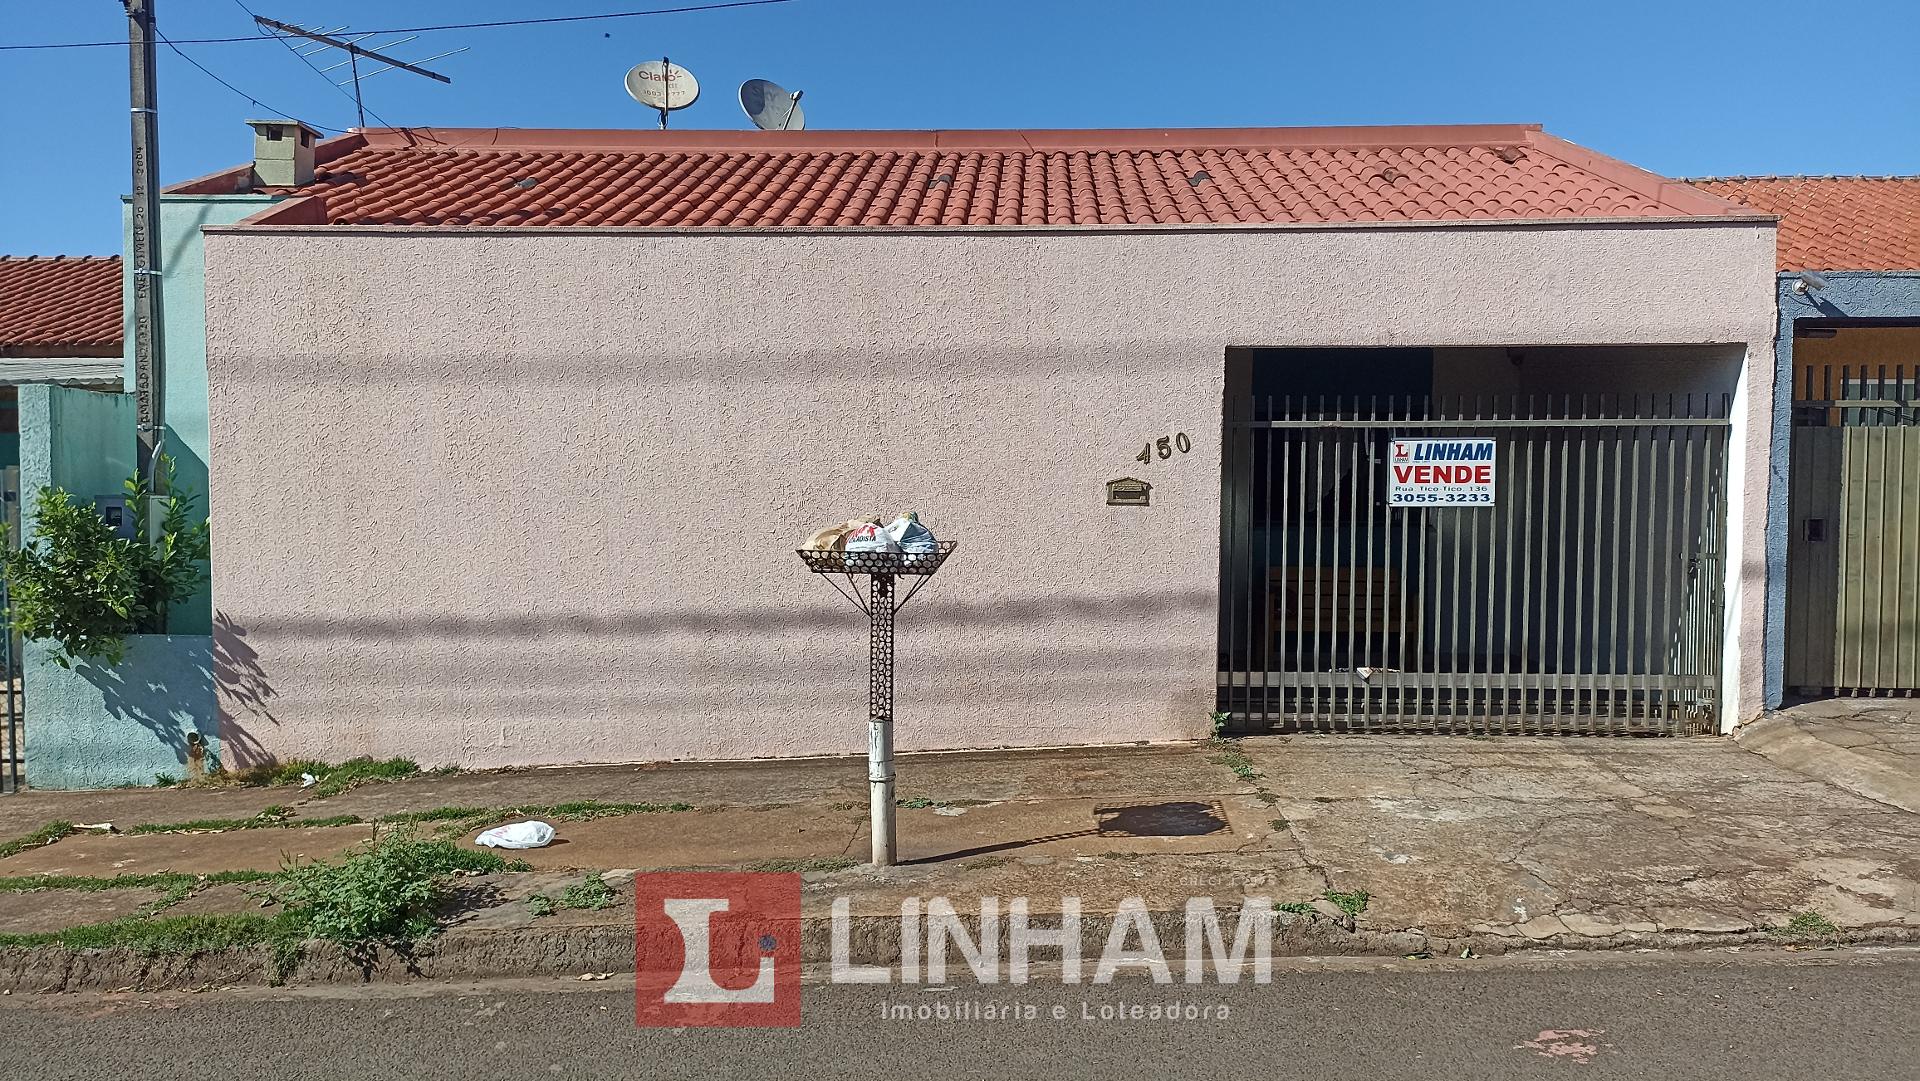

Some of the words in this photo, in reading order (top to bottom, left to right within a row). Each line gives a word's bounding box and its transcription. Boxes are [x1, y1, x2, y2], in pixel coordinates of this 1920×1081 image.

[135, 146, 144, 176] 2004
[1136, 432, 1191, 465] 450
[1414, 443, 1493, 461] LINHAM
[1393, 465, 1491, 484] VENDE
[1393, 493, 1491, 502] 3055-3233
